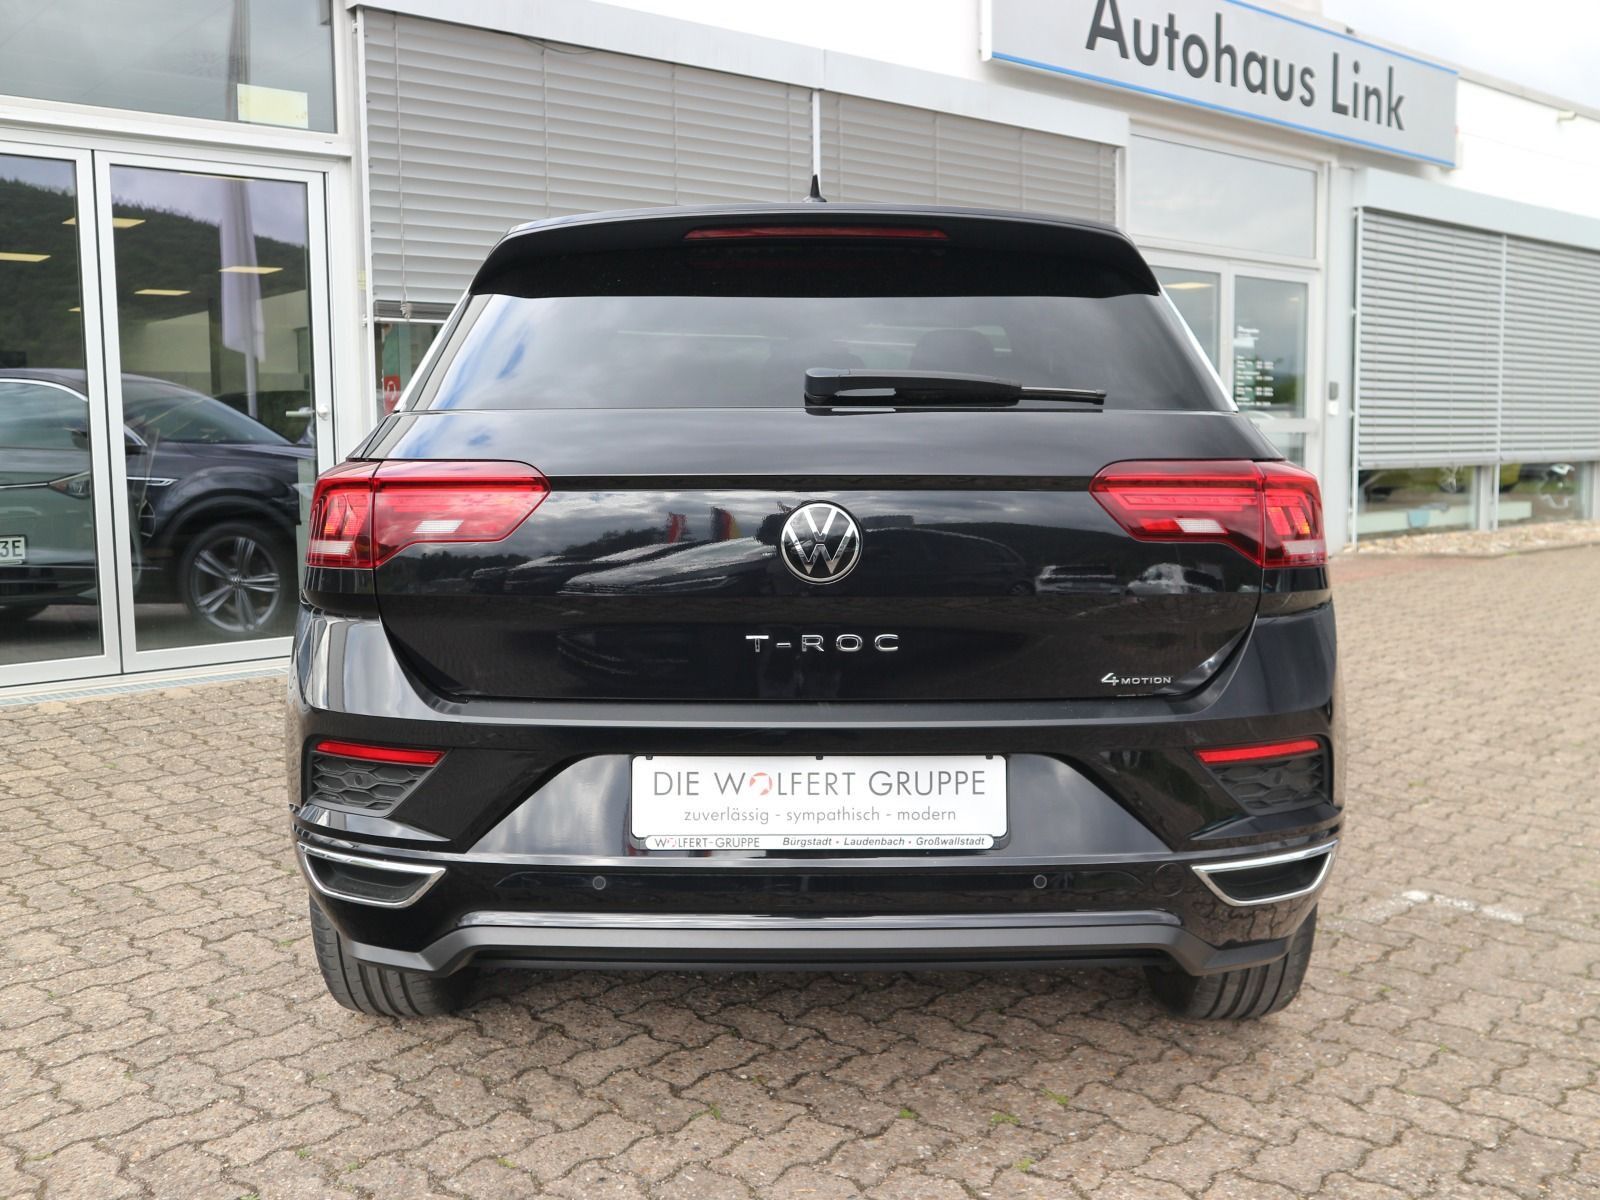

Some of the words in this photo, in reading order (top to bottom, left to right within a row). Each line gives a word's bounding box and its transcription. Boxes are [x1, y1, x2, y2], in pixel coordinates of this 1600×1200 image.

[1085, 0, 1316, 108] Autohaus
[1332, 51, 1405, 131] Link
[745, 634, 899, 652] T-ROC
[654, 771, 699, 796] DIE
[713, 771, 856, 796] WOLFERT
[868, 770, 985, 796] GRUPPE
[684, 806, 769, 824] zuverlässig
[786, 805, 880, 824] sympathisch
[897, 805, 956, 821] modern
[843, 836, 905, 846] Laudenbach
[916, 835, 985, 846] Großwallstadt
